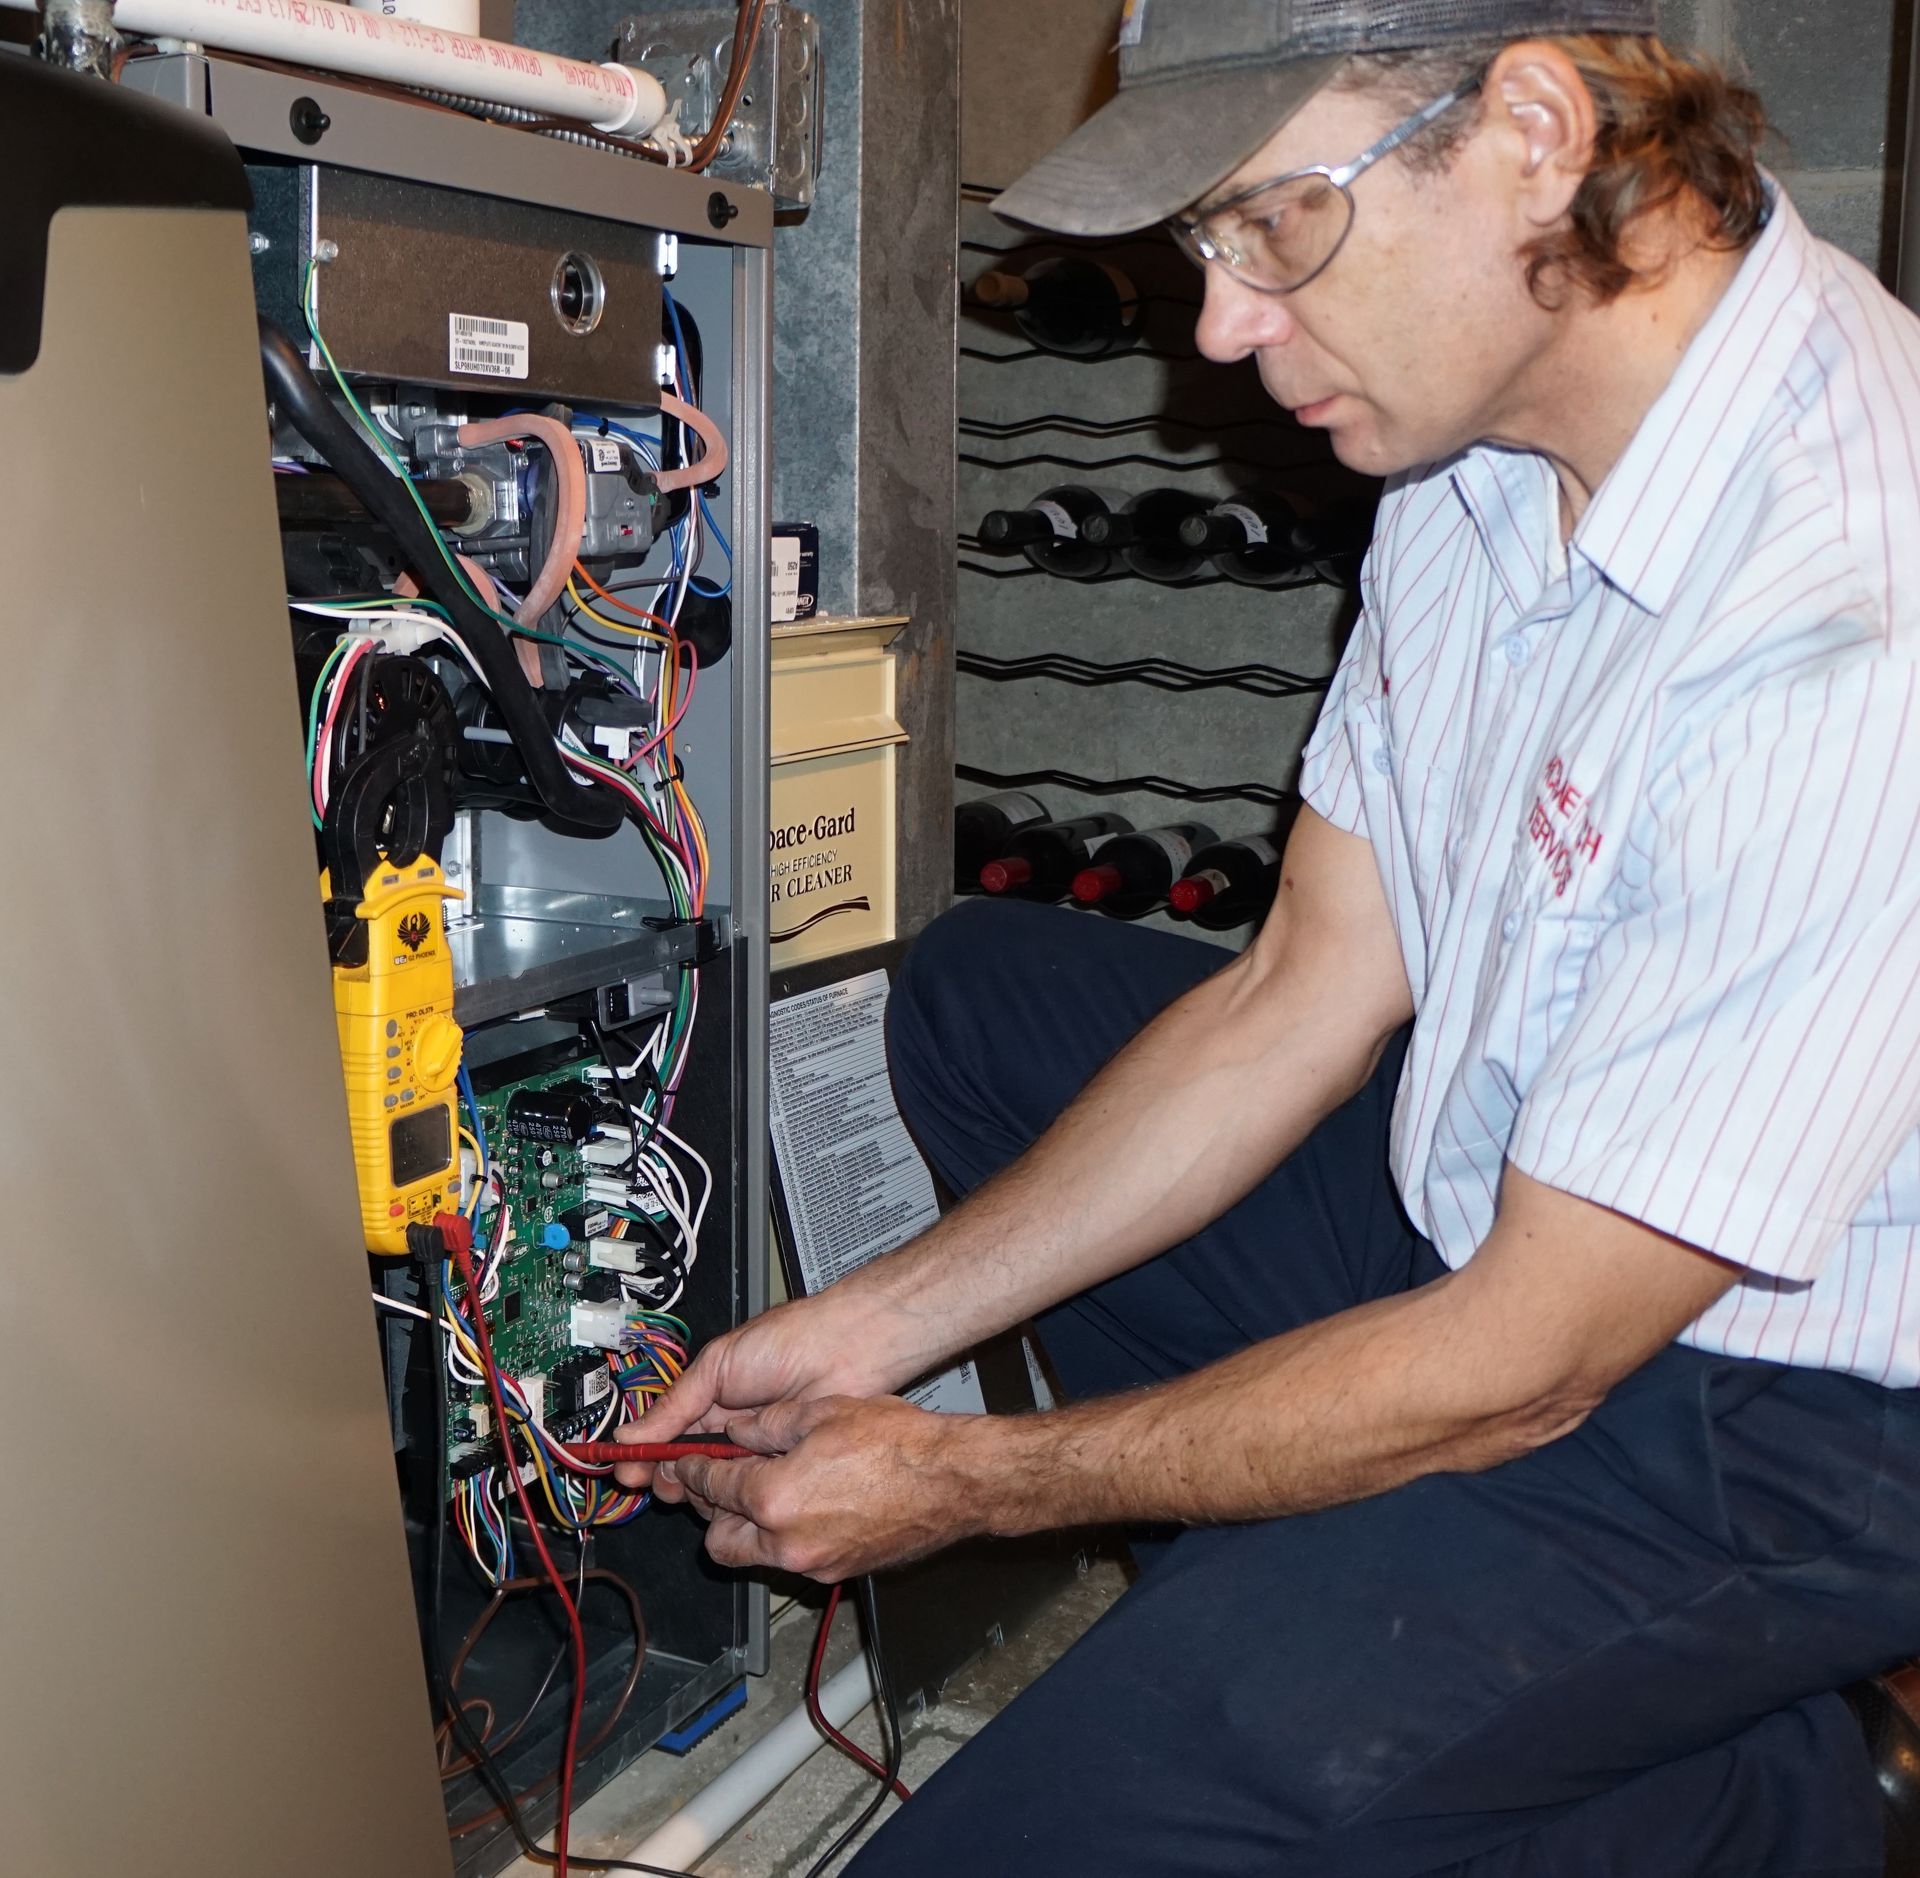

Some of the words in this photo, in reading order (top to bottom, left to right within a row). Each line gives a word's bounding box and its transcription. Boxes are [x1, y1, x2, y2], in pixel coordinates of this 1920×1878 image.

[450, 37, 486, 63] WATER
[490, 44, 543, 76] DRINKING
[770, 860, 790, 878] HIGH
[792, 849, 837, 873] EFFICIENCY
[786, 864, 853, 898] CLEANER
